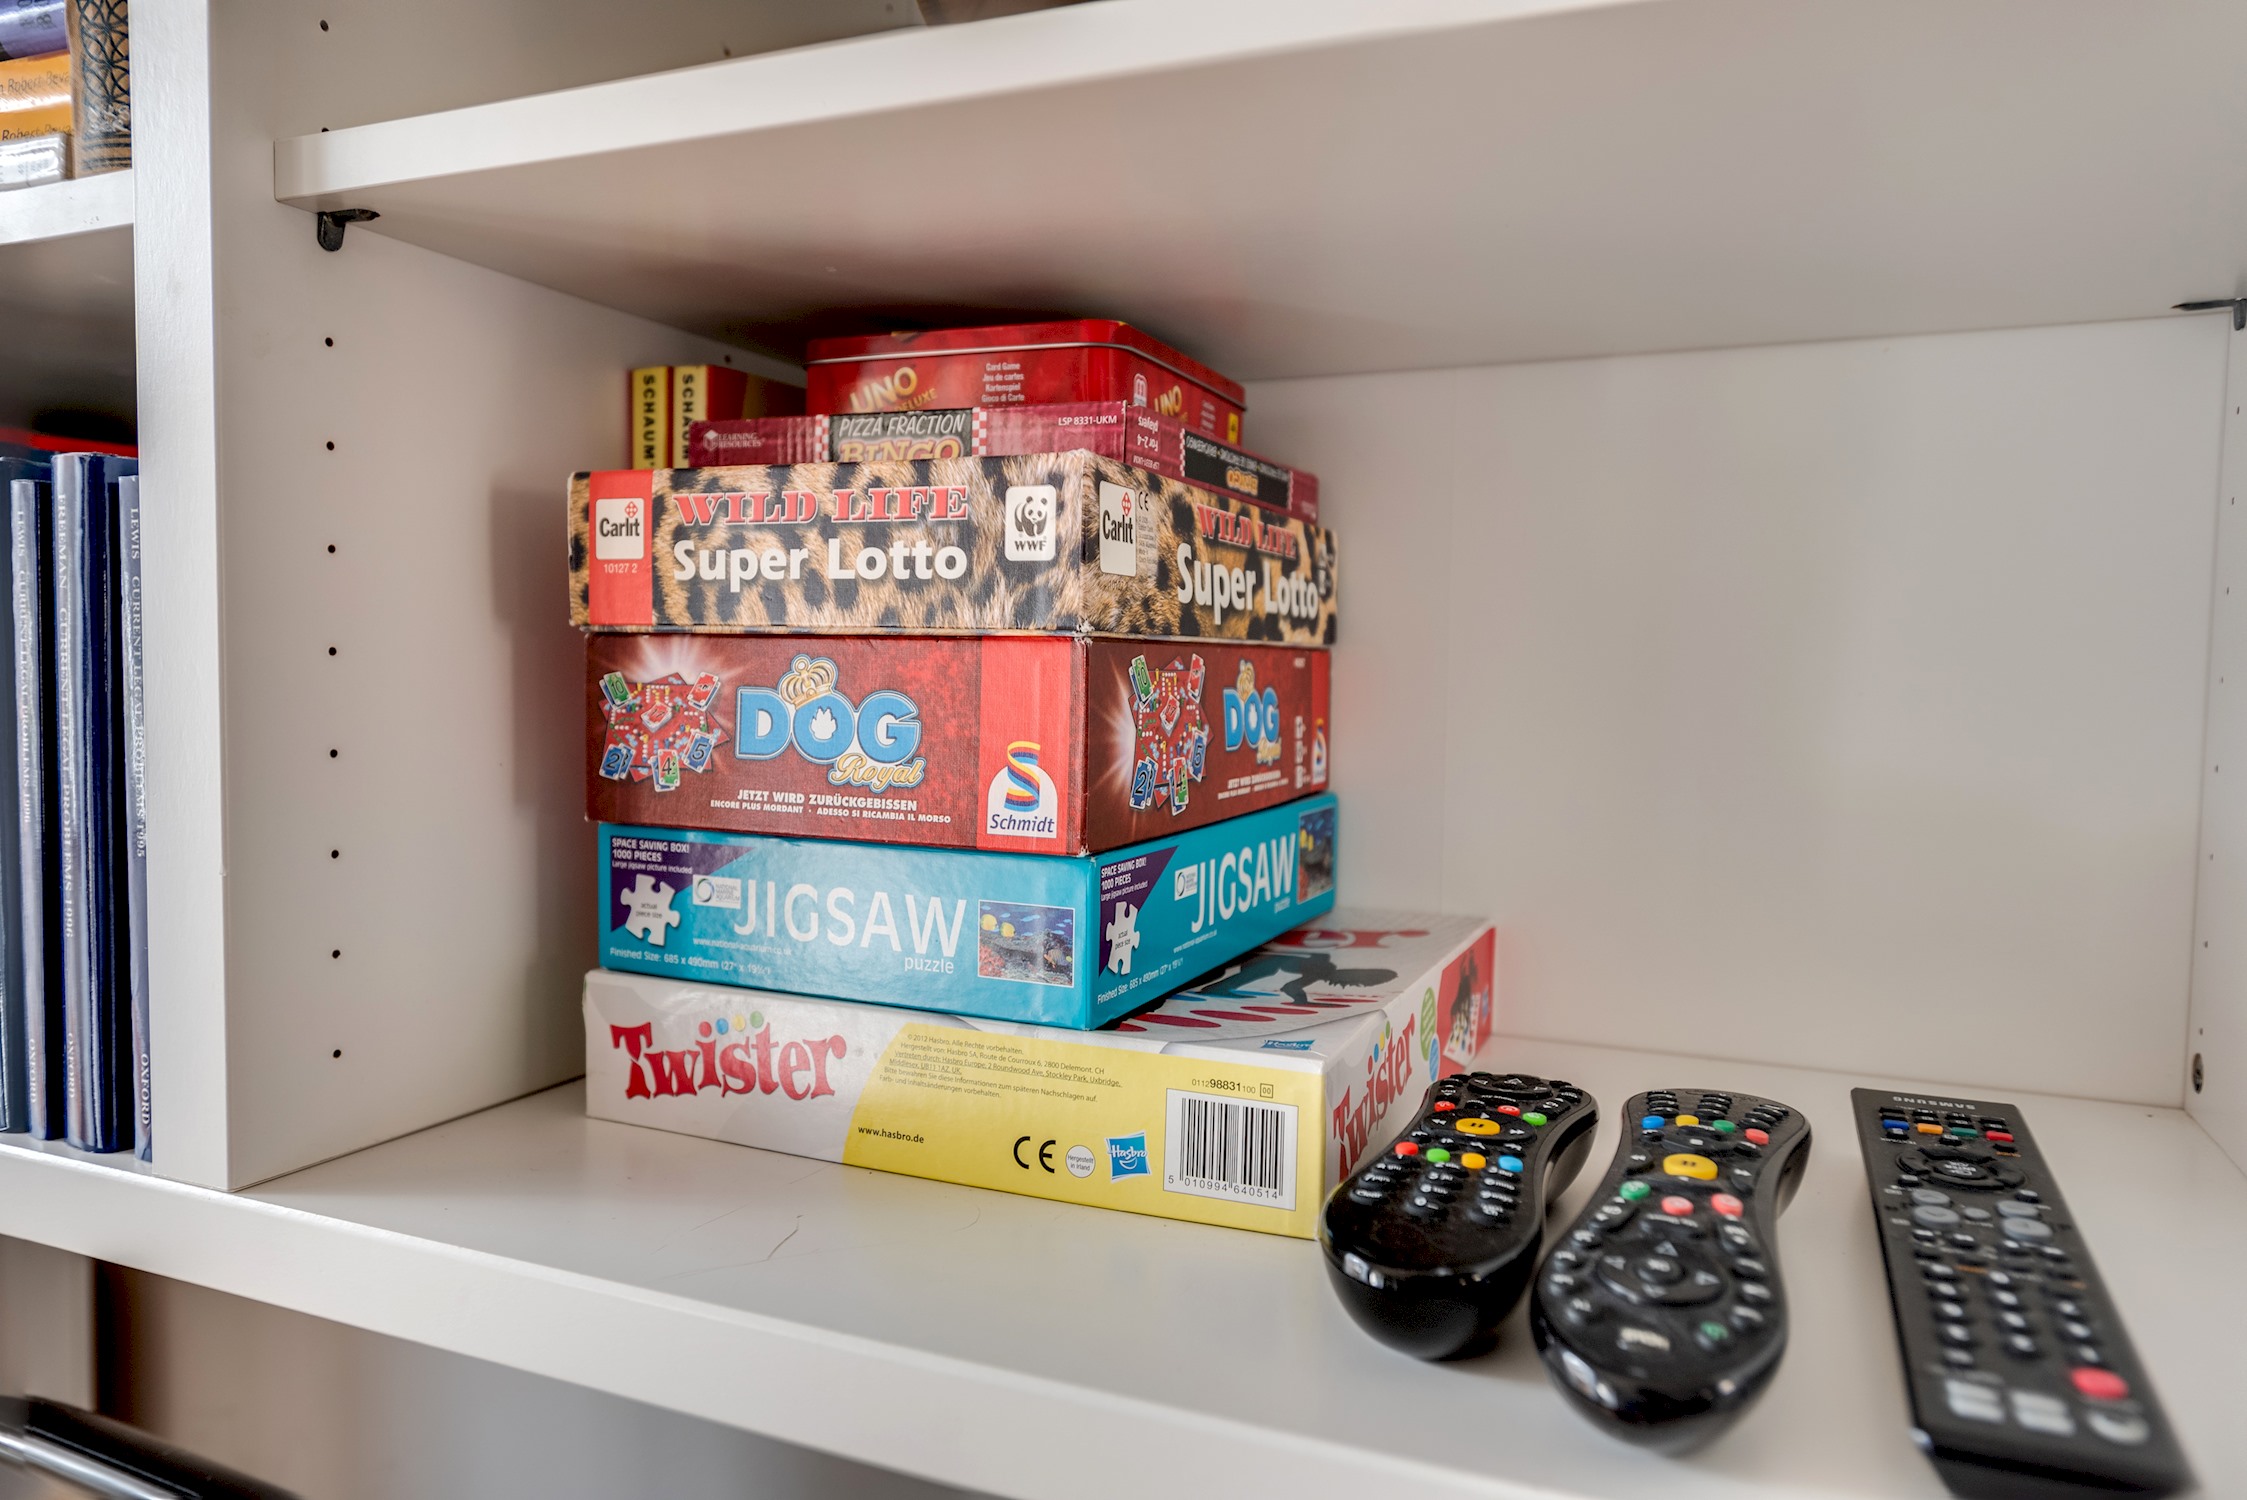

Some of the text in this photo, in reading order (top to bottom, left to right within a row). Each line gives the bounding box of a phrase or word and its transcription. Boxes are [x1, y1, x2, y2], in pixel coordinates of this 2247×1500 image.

[982, 373, 1025, 382] Jeu de cartes
[985, 362, 1021, 372] Card Game
[850, 366, 918, 412] UNO
[982, 393, 1025, 403] Gioco di Carte
[985, 383, 1021, 393] Kartenspiel
[838, 413, 966, 437] PIZZA FRACTION
[1058, 414, 1118, 426] LSP 8331-UKM
[1137, 416, 1159, 433] players
[718, 432, 758, 441] LEARNING
[718, 440, 762, 449] RESOURCES
[1136, 433, 1159, 452] For 2-4
[839, 437, 964, 463] BINGO
[672, 486, 969, 526] WILD LIFE
[17, 511, 26, 557] LEWIS
[130, 508, 140, 559] LEWIS
[600, 516, 640, 538] Carlit
[1102, 509, 1134, 545] Carlit
[1196, 503, 1252, 549] WILD
[1256, 521, 1297, 560] LIFE
[1014, 540, 1047, 551] WWF
[604, 563, 638, 574] 10127 2
[673, 538, 968, 593] Super Lotto
[1176, 543, 1257, 626] Super
[1263, 559, 1319, 620] Lotto
[131, 576, 142, 658] CURRENT
[133, 665, 143, 719] LEGAL
[610, 680, 625, 695] 10
[58, 495, 74, 937] FREEMAN CURRENT LEGAL PROBLEMS 1996
[735, 686, 922, 766] DOG
[1223, 687, 1280, 752] DOG
[605, 752, 621, 770] 2
[691, 743, 708, 760] 5
[134, 725, 145, 817] PROBLEMS
[829, 753, 926, 792] Royal
[1135, 771, 1147, 794] 2
[737, 789, 918, 811] JETZT WIRD ZURÜCKGEBISSEN
[710, 799, 951, 824] ENCORE PLUS MORDANT ADESSO SI RICAMBIA IL MORSO
[990, 813, 1055, 833] Schmidt
[612, 838, 690, 853] SPACE SAVING BOX!
[612, 849, 662, 862] 1000 PIECES
[612, 861, 693, 874] Large jigsaw picture included
[1101, 856, 1147, 878] SPACE SAVING BOX!
[1101, 873, 1132, 891] 1000 PIECES
[1191, 832, 1296, 934] JIGSAW
[635, 911, 663, 919] piece size
[734, 879, 967, 958] JIGSAW
[610, 947, 719, 969] Finished Size: 685 x 490mm
[904, 956, 954, 974] puzzle
[1097, 988, 1118, 1005] Finished
[913, 1034, 928, 1042] 2012
[964, 1041, 985, 1050] Rechte
[986, 1043, 1024, 1055] vorbehalten.
[67, 1033, 75, 1098] OXFORD
[610, 1021, 848, 1101] Twister
[895, 1050, 922, 1061] Vertreten
[942, 1056, 963, 1066] Hasbro
[993, 1063, 1031, 1075] Roundwood
[1045, 1070, 1072, 1081] Stockley
[900, 1042, 932, 1053] Hergestellt
[946, 1048, 968, 1057] Hasbro
[979, 1052, 997, 1061] Route
[998, 1054, 1007, 1062] de
[1007, 1056, 1037, 1066] Courroux
[1043, 1060, 1060, 1069] 2800
[1094, 1066, 1105, 1075] CH
[28, 1038, 36, 1103] OXFORD
[141, 1053, 151, 1125] OXFORD
[884, 1066, 897, 1075] Bitte
[898, 1068, 928, 1079] bewahren
[928, 1071, 938, 1080] Sie
[938, 1073, 955, 1082] diese
[955, 1076, 998, 1088] Informationen
[998, 1083, 1012, 1091] zum
[1012, 1084, 1040, 1095] späteren
[1040, 1088, 1085, 1101] Nachschlagen
[894, 1077, 907, 1085] und
[907, 1078, 962, 1094] Inhaltsänderungen
[963, 1087, 1001, 1099] vorbehalten.
[1333, 1013, 1415, 1183] Twister
[1893, 1096, 1976, 1110] SAMSUNG
[858, 1126, 925, 1144] www.hasbro.de
[1013, 1135, 1056, 1174] CE
[1067, 1154, 1094, 1165] Hergestellt
[1110, 1144, 1148, 1160] Hasbro
[1076, 1163, 1091, 1172] Irland
[1168, 1175, 1175, 1184] 5
